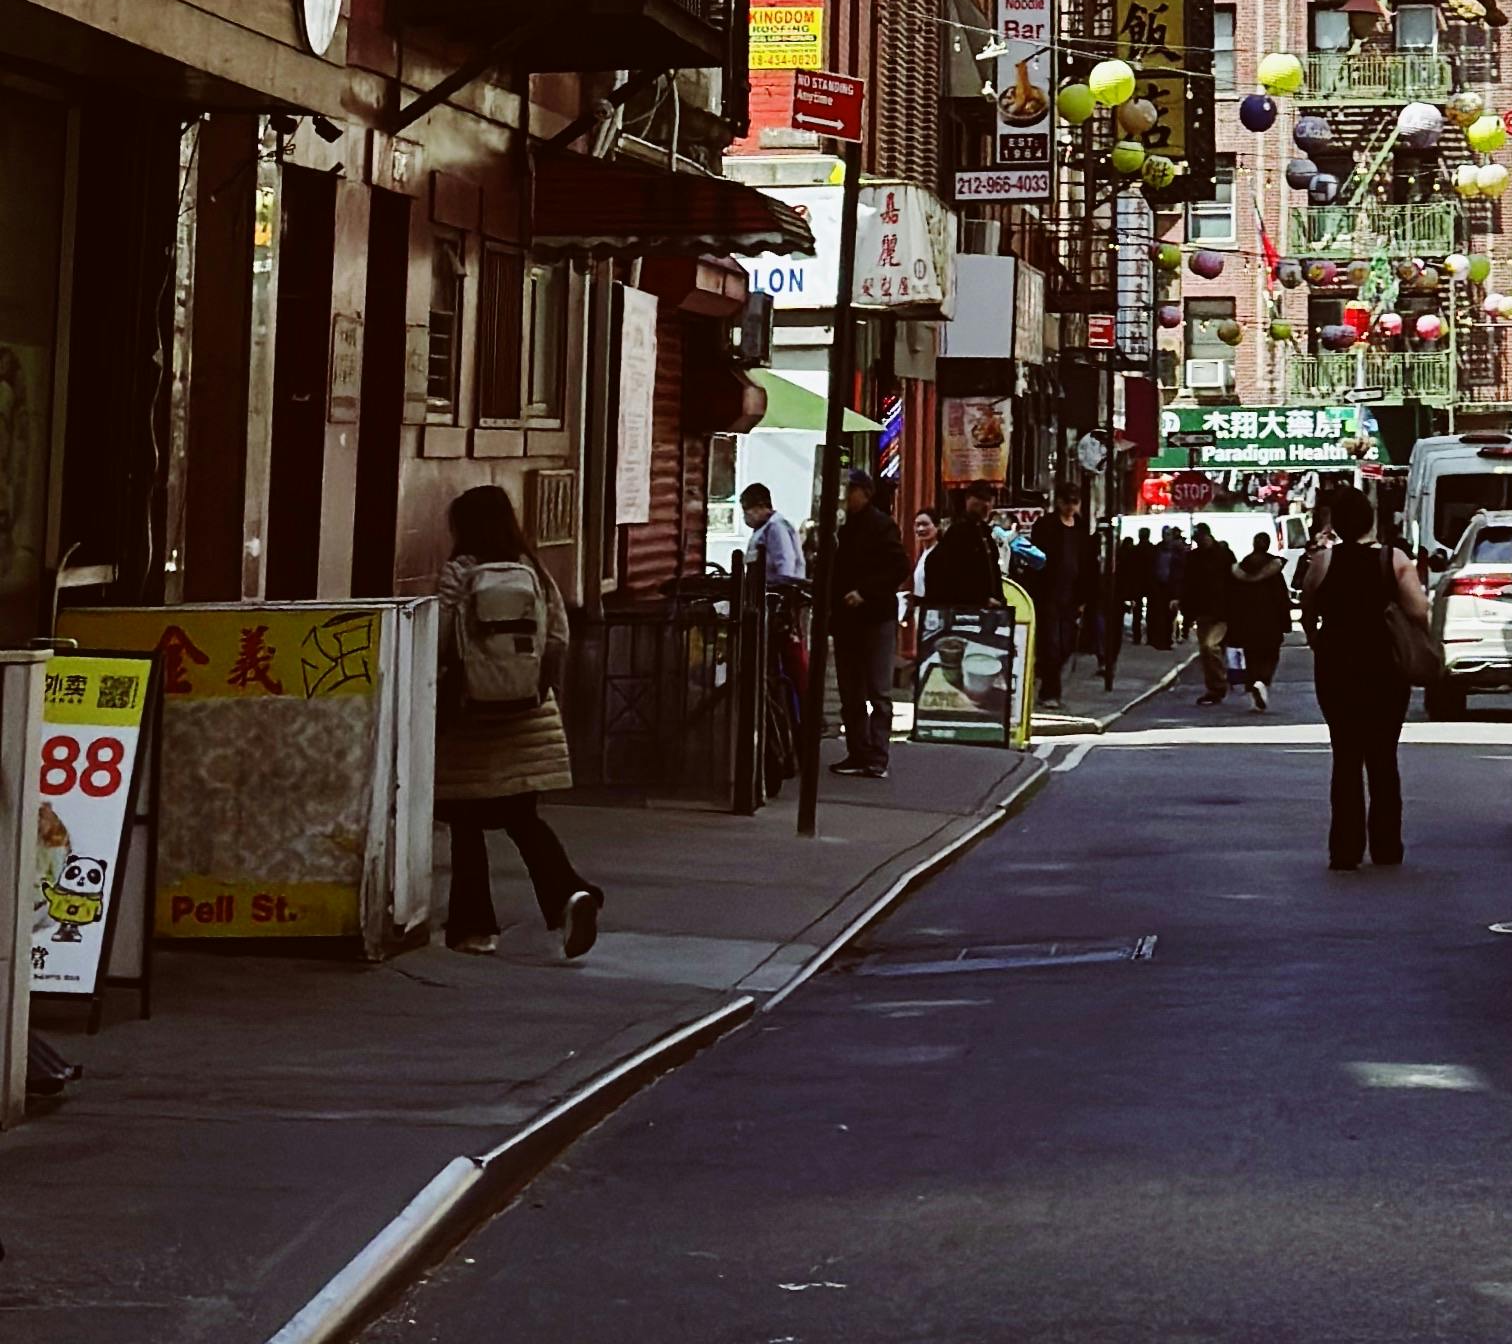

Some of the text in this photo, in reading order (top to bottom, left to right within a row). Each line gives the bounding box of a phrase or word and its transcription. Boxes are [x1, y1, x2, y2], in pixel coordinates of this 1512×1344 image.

[749, 10, 816, 25] KINGDOM
[1003, 19, 1045, 41] Bar
[797, 73, 854, 96] NO STANDING
[1201, 445, 1287, 465] Paradigm
[1289, 445, 1350, 463] Health
[1174, 485, 1209, 501] STOP
[171, 894, 298, 924] Pell St.
